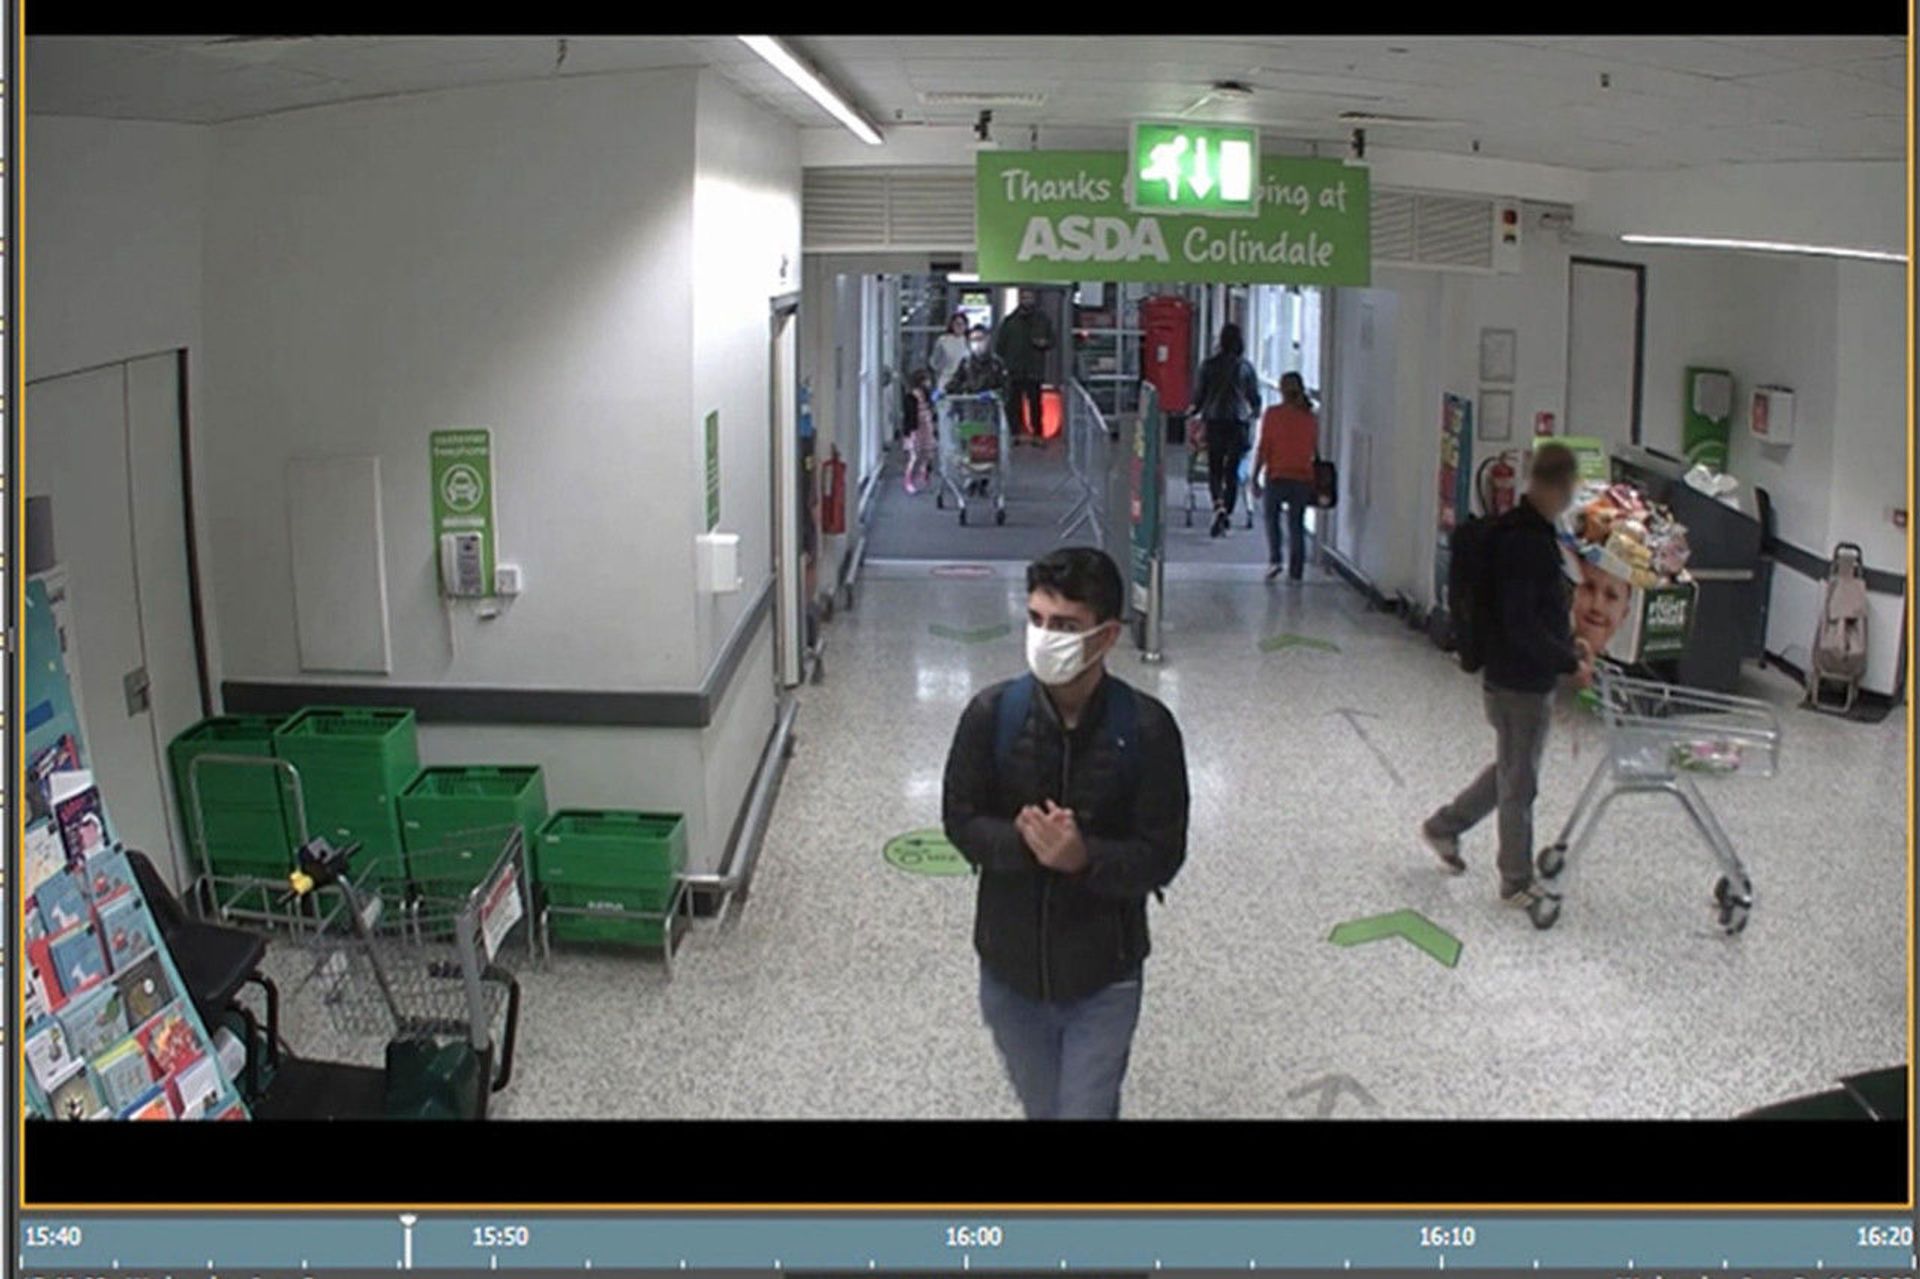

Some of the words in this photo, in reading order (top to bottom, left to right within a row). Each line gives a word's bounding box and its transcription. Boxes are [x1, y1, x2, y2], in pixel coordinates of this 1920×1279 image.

[1001, 168, 1111, 203] Thanks
[1318, 181, 1348, 213] at
[1017, 215, 1170, 263] ASDA
[1183, 226, 1335, 267] Colindale
